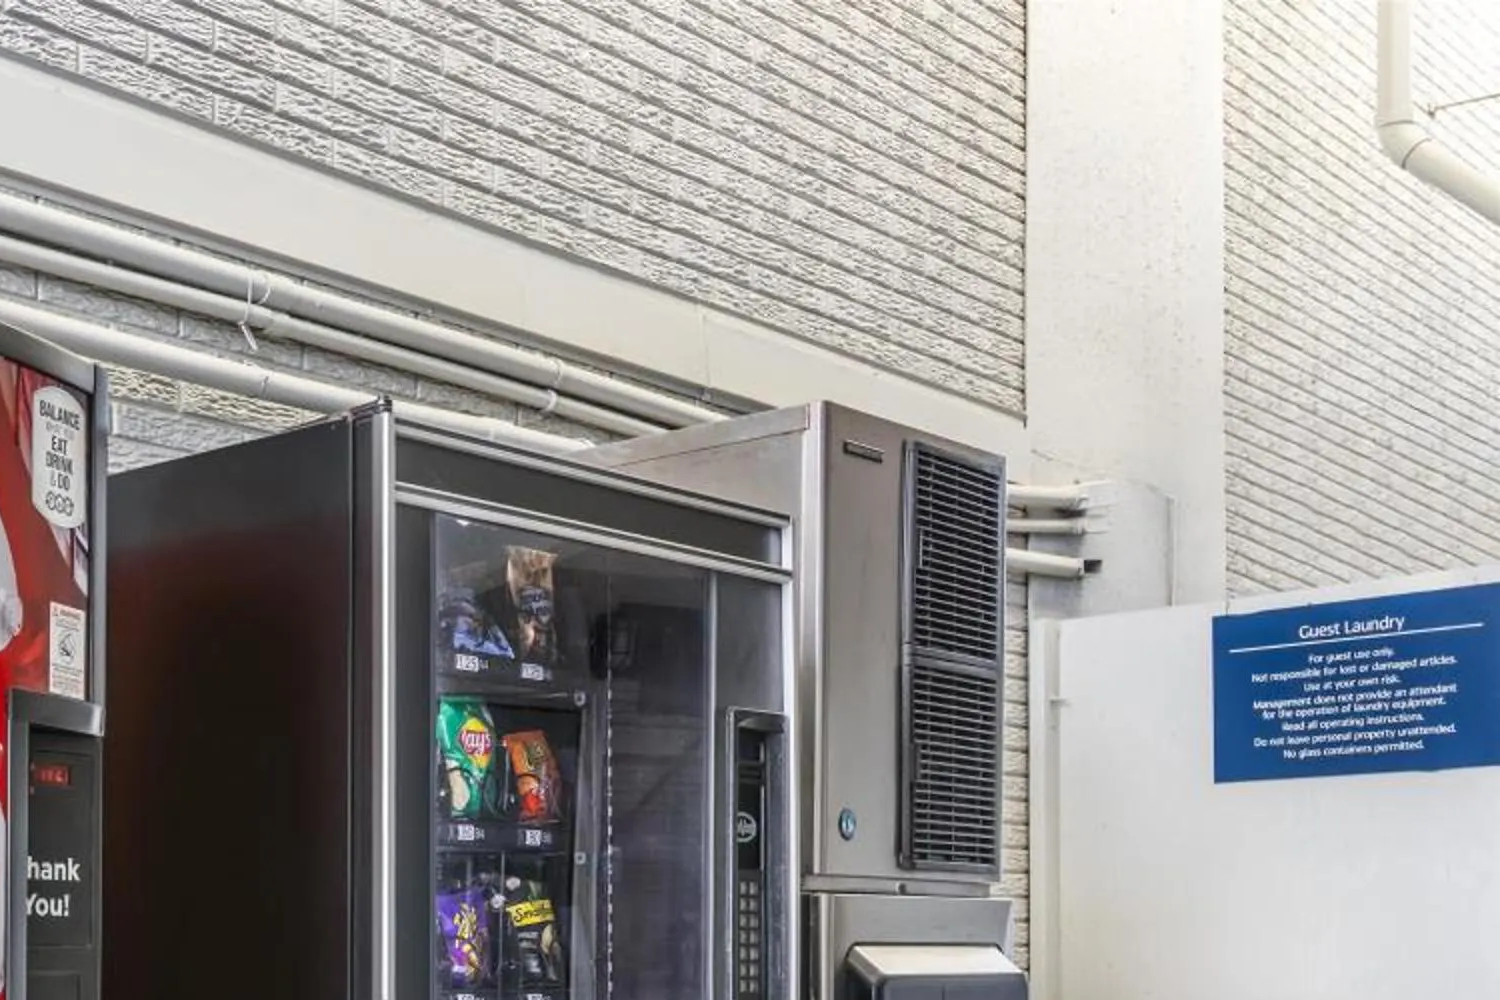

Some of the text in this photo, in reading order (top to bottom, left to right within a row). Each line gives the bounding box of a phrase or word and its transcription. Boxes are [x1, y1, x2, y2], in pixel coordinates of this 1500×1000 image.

[40, 399, 80, 431] BALANCE
[52, 435, 68, 456] EAT
[46, 451, 73, 476] DRINK
[58, 473, 71, 492] DO
[1298, 615, 1405, 639] Guest Laundry
[1251, 654, 1458, 683] Not responsible for lost or damaged articles.
[1308, 653, 1324, 664] For
[1325, 651, 1352, 664] guest
[1353, 650, 1370, 660] use
[1303, 674, 1401, 692] Use at your own risk.
[1252, 683, 1457, 710] Management does not provide an attendant
[1262, 696, 1446, 720] for the operation of laundry equipment.
[1281, 712, 1425, 731] Read all operating instructions.
[1253, 722, 1457, 747] Do not leave personal property unattended.
[1283, 739, 1425, 760] No glass containers permitted.
[26, 856, 81, 882] hank
[25, 893, 70, 917] You!
